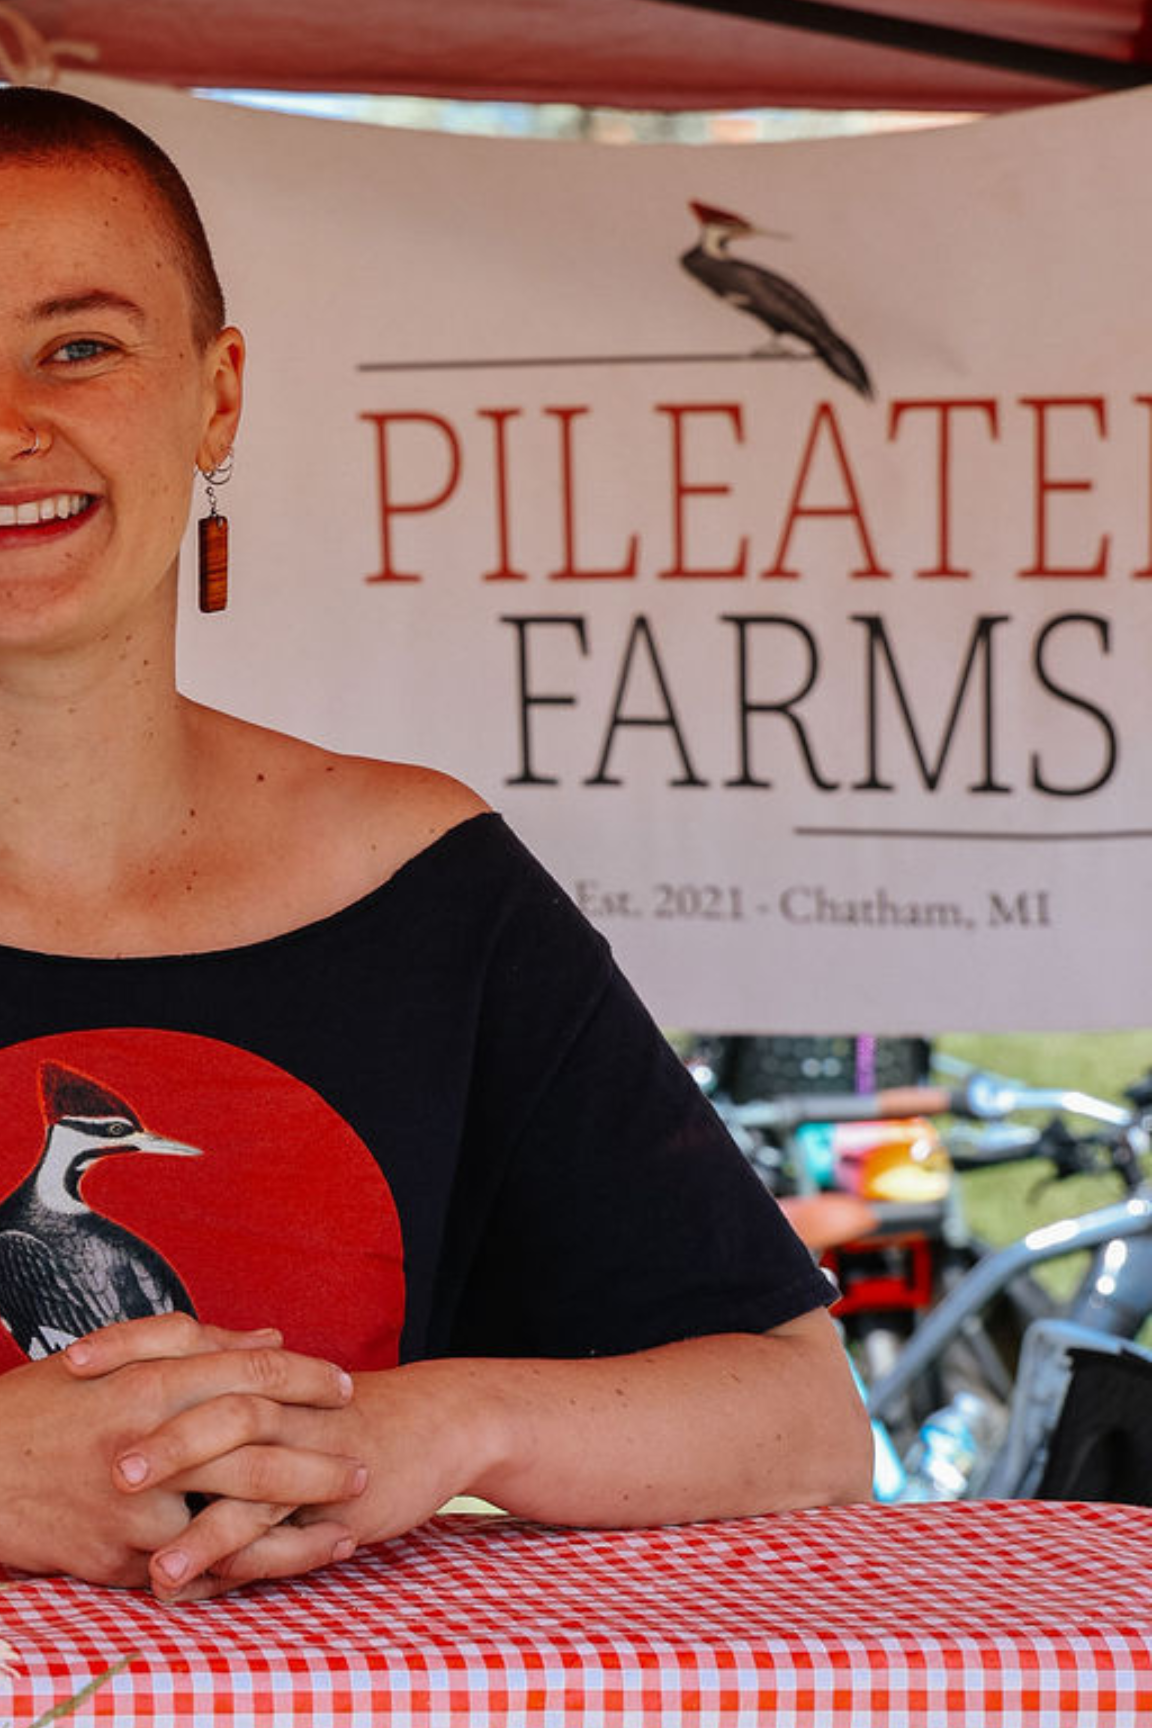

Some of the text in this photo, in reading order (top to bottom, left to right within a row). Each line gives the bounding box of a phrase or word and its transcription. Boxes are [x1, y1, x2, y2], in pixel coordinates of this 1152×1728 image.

[359, 396, 1152, 584] PILEATE
[499, 612, 1119, 797] FARMS
[575, 880, 644, 918] Est.
[653, 884, 745, 921] 2021
[778, 886, 975, 931] Chatham,
[987, 890, 1052, 927] MI
